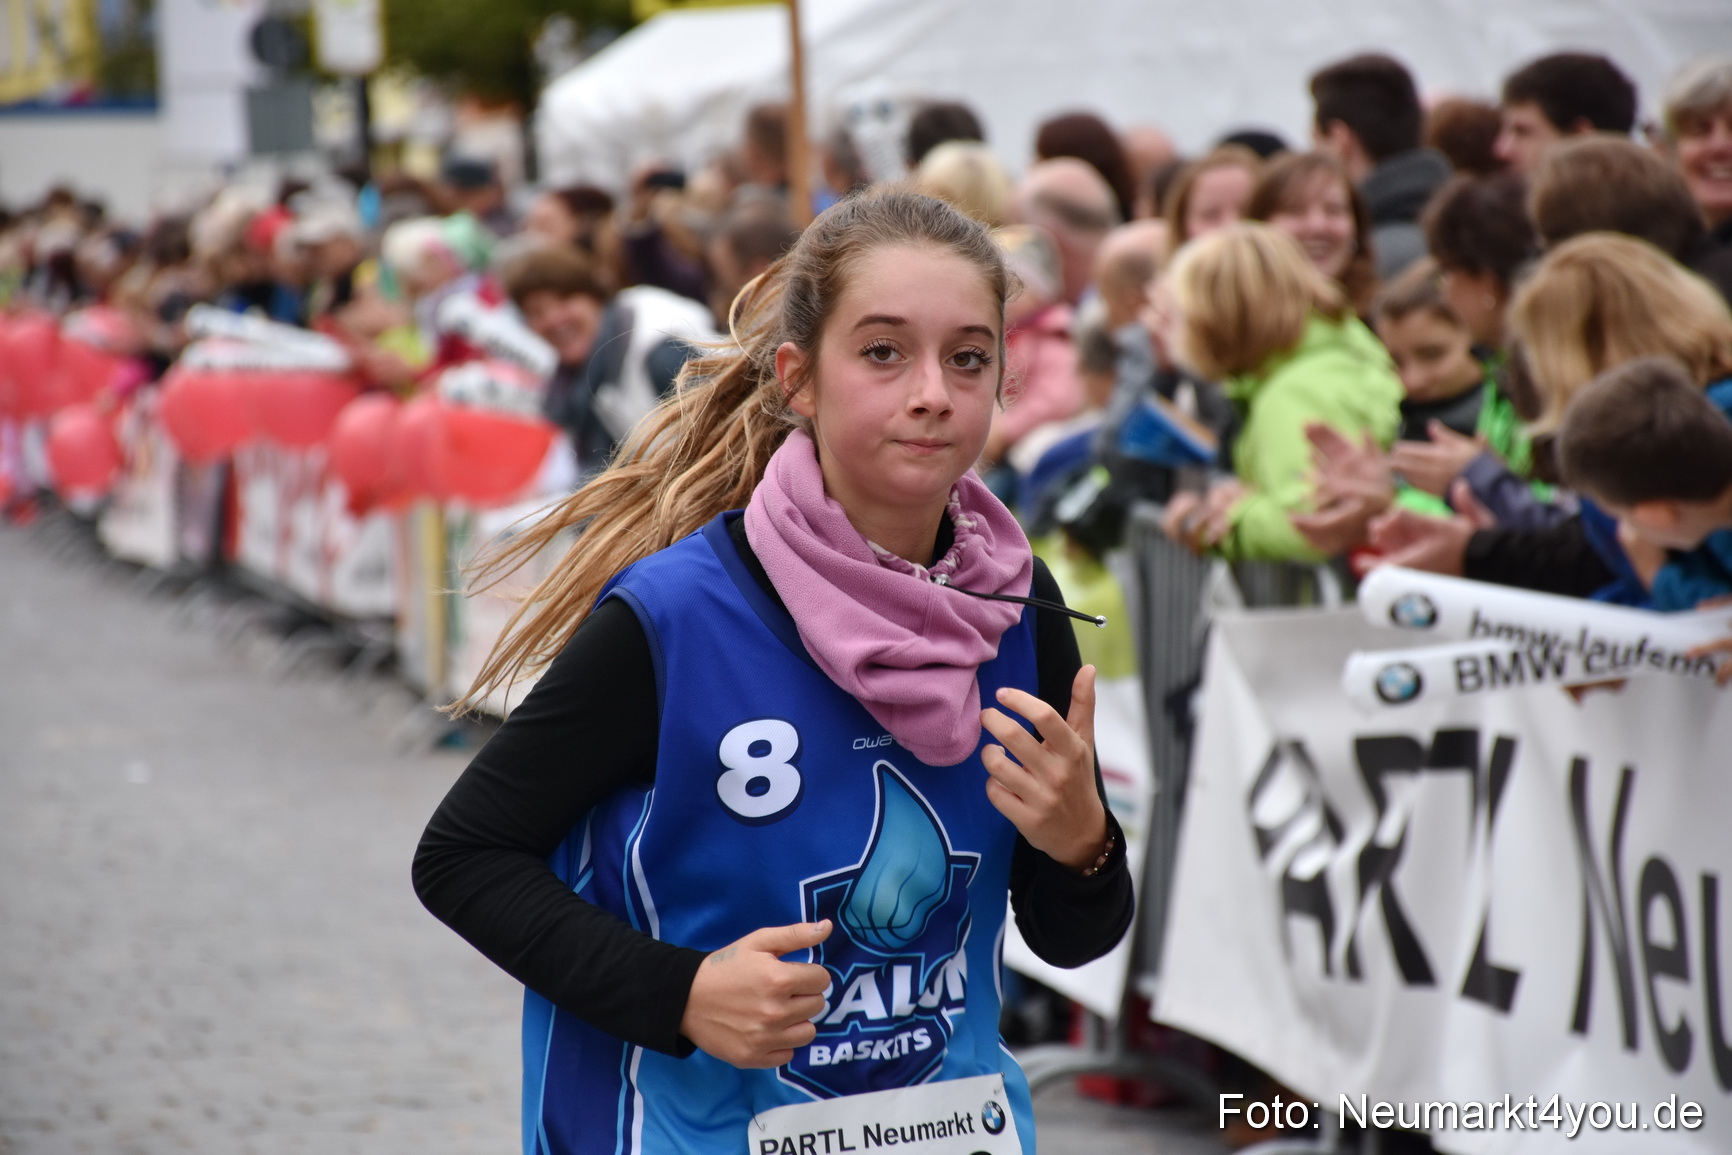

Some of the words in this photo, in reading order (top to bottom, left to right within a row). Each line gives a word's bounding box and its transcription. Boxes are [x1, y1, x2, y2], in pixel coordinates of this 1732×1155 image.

[1455, 647, 1566, 693] BMW
[853, 734, 895, 750] owa
[716, 719, 801, 818] 8
[760, 1128, 856, 1155] PARTL
[863, 1111, 975, 1149] Neumarkt
